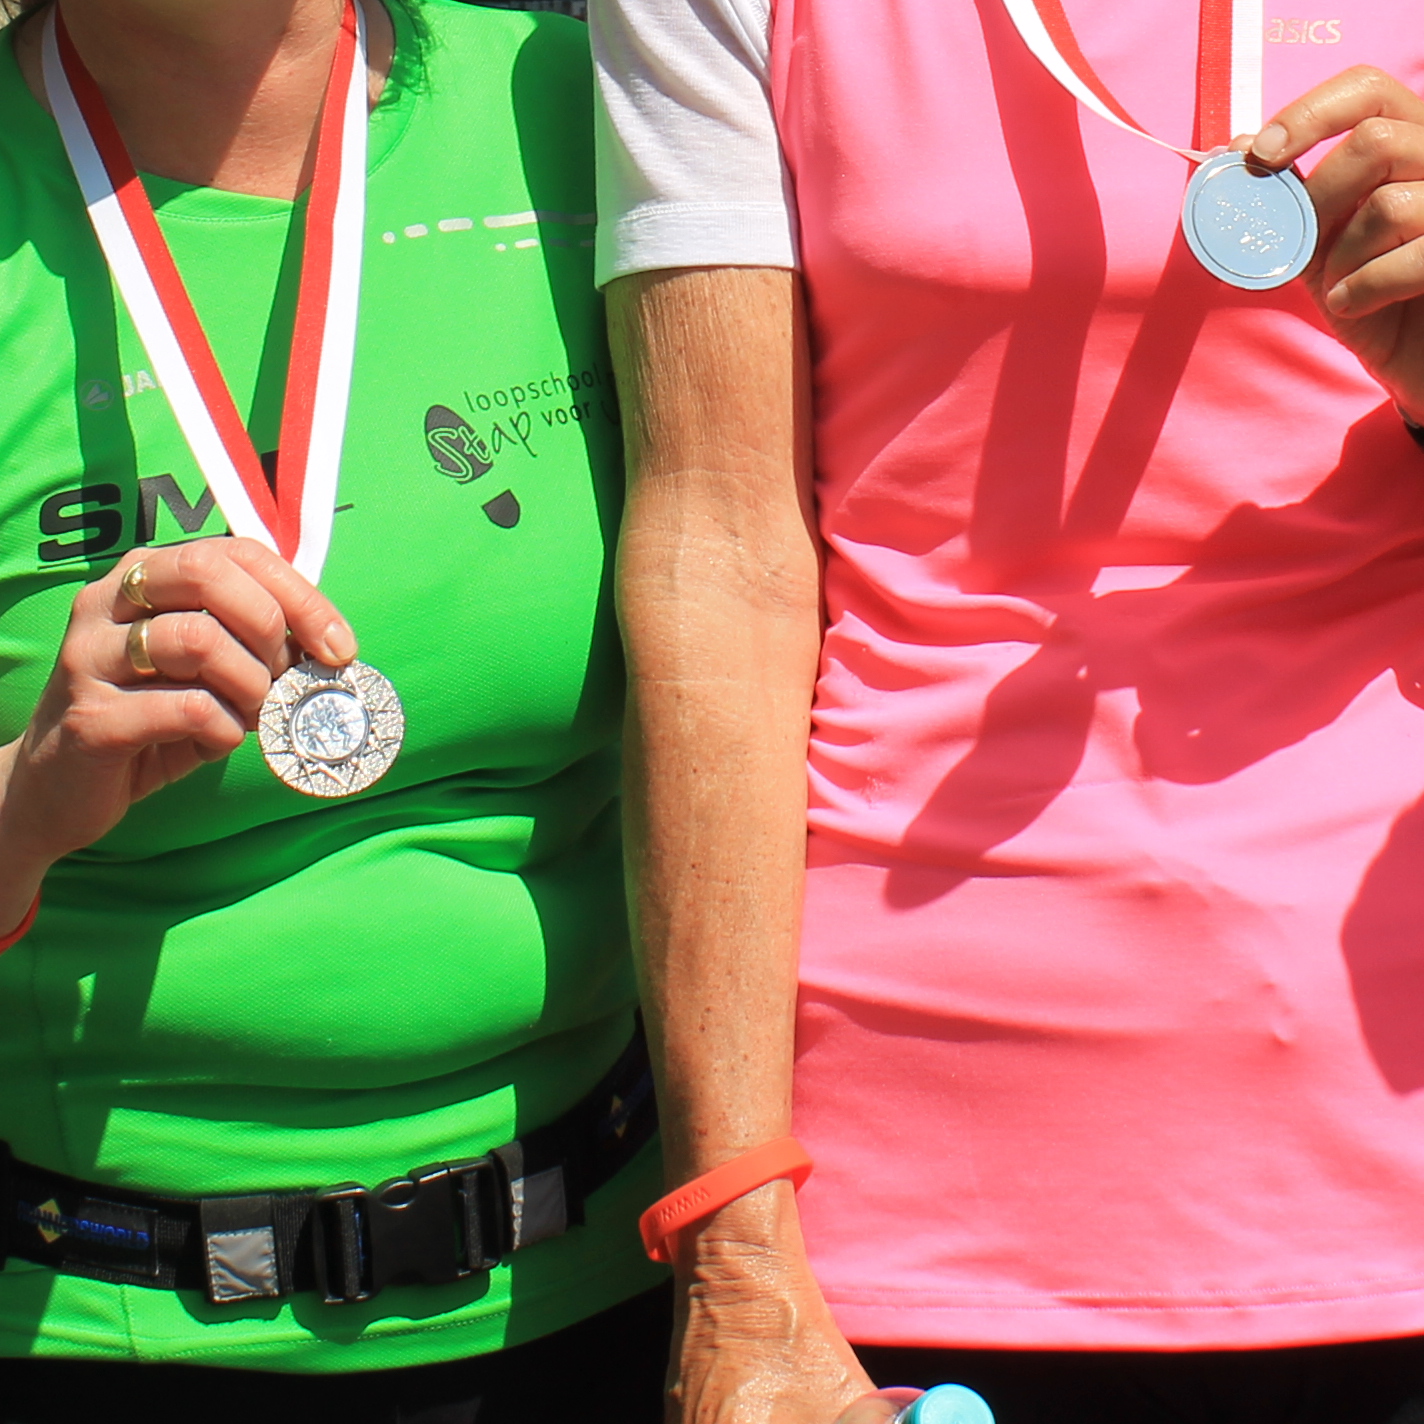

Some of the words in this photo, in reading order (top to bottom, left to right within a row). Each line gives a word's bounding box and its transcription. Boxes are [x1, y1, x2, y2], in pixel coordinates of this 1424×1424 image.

[463, 362, 603, 413] loopschool
[427, 411, 538, 481] Stap
[541, 401, 591, 427] voor
